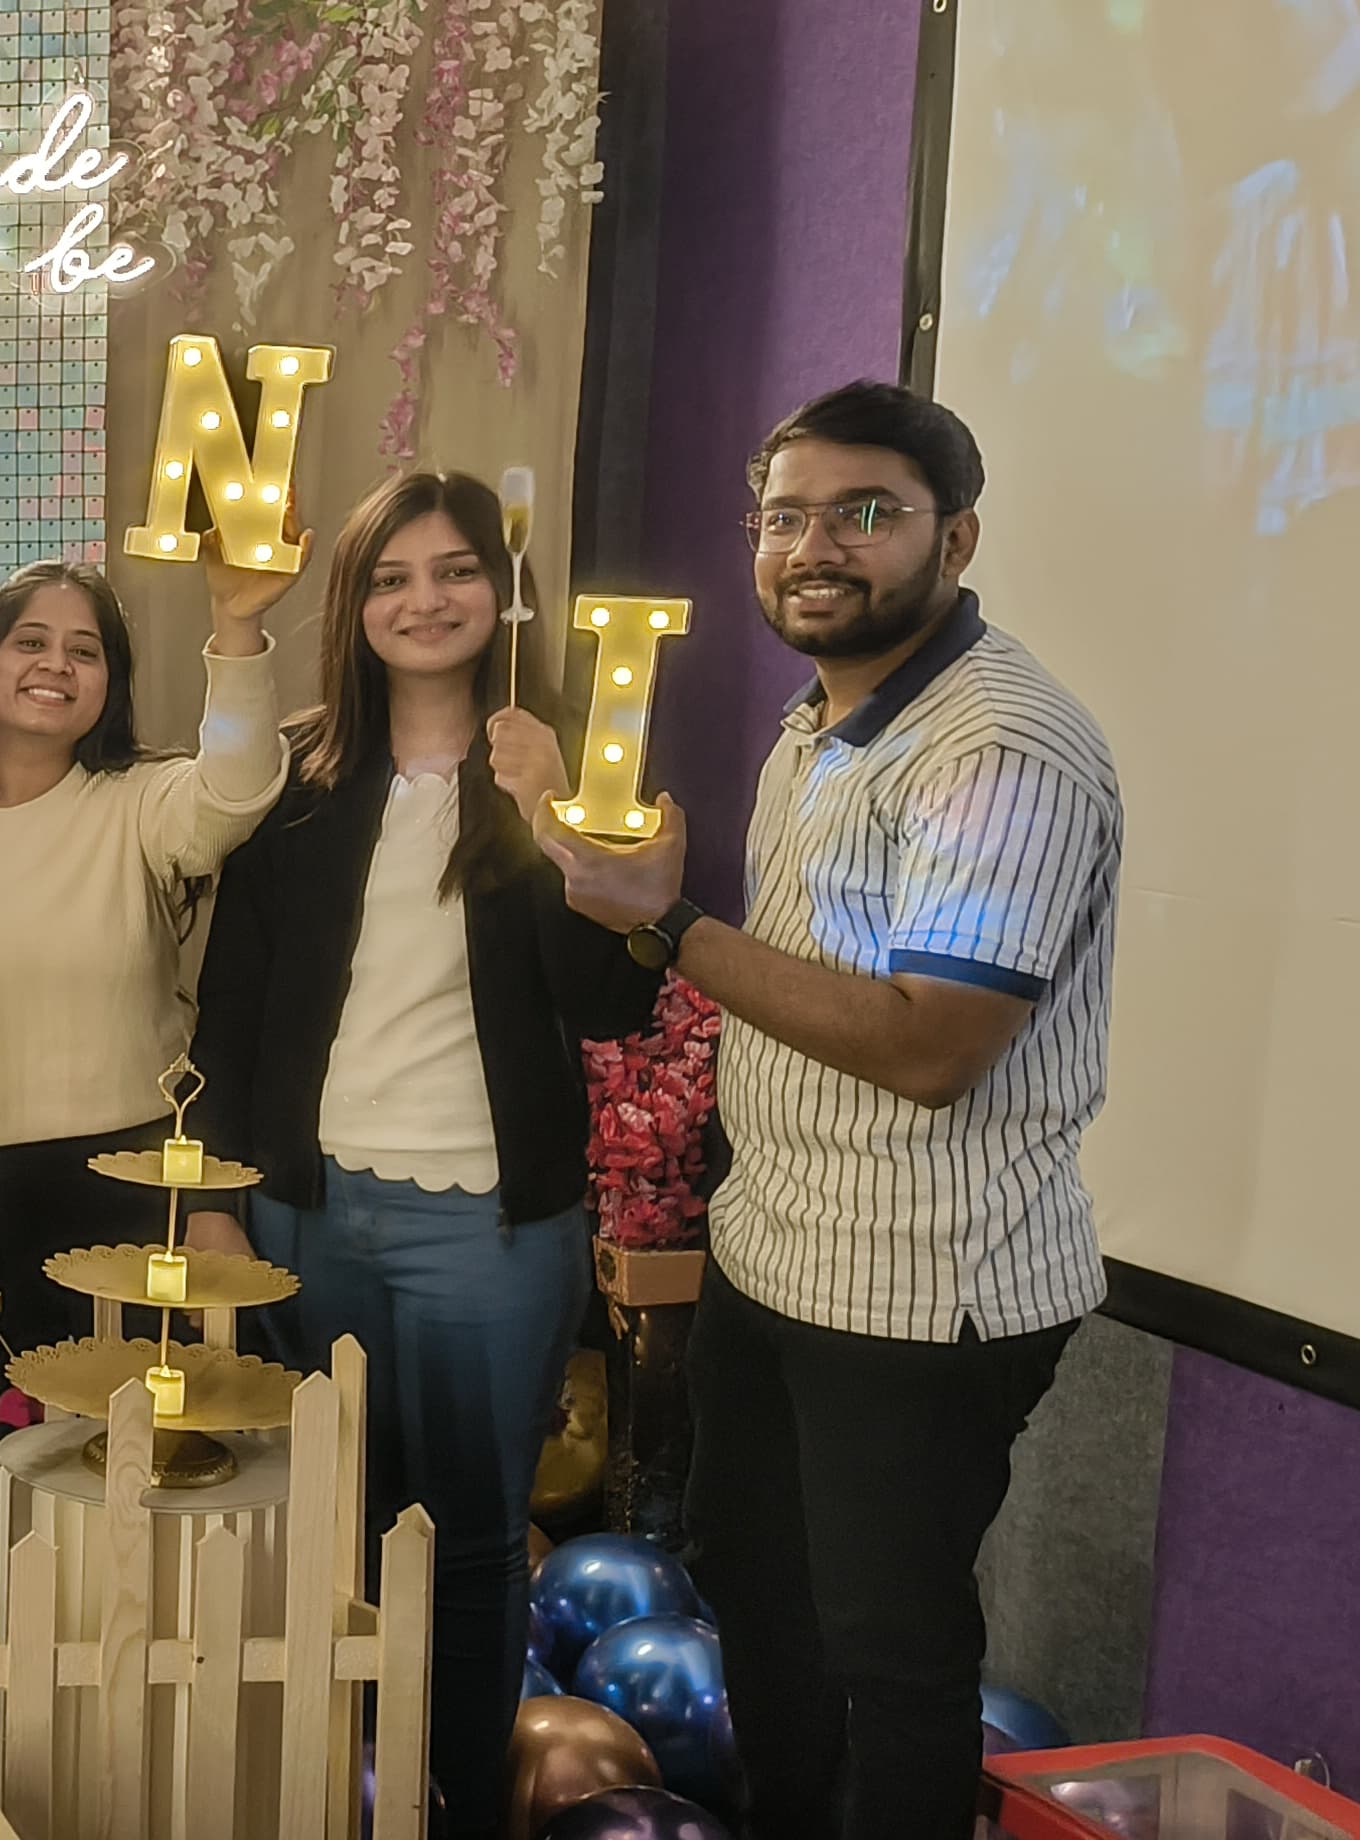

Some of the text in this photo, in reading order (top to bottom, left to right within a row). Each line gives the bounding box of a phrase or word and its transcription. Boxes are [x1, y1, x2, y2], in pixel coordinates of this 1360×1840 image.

[25, 203, 155, 293] be
[124, 333, 336, 574] N
[551, 594, 692, 838] I
